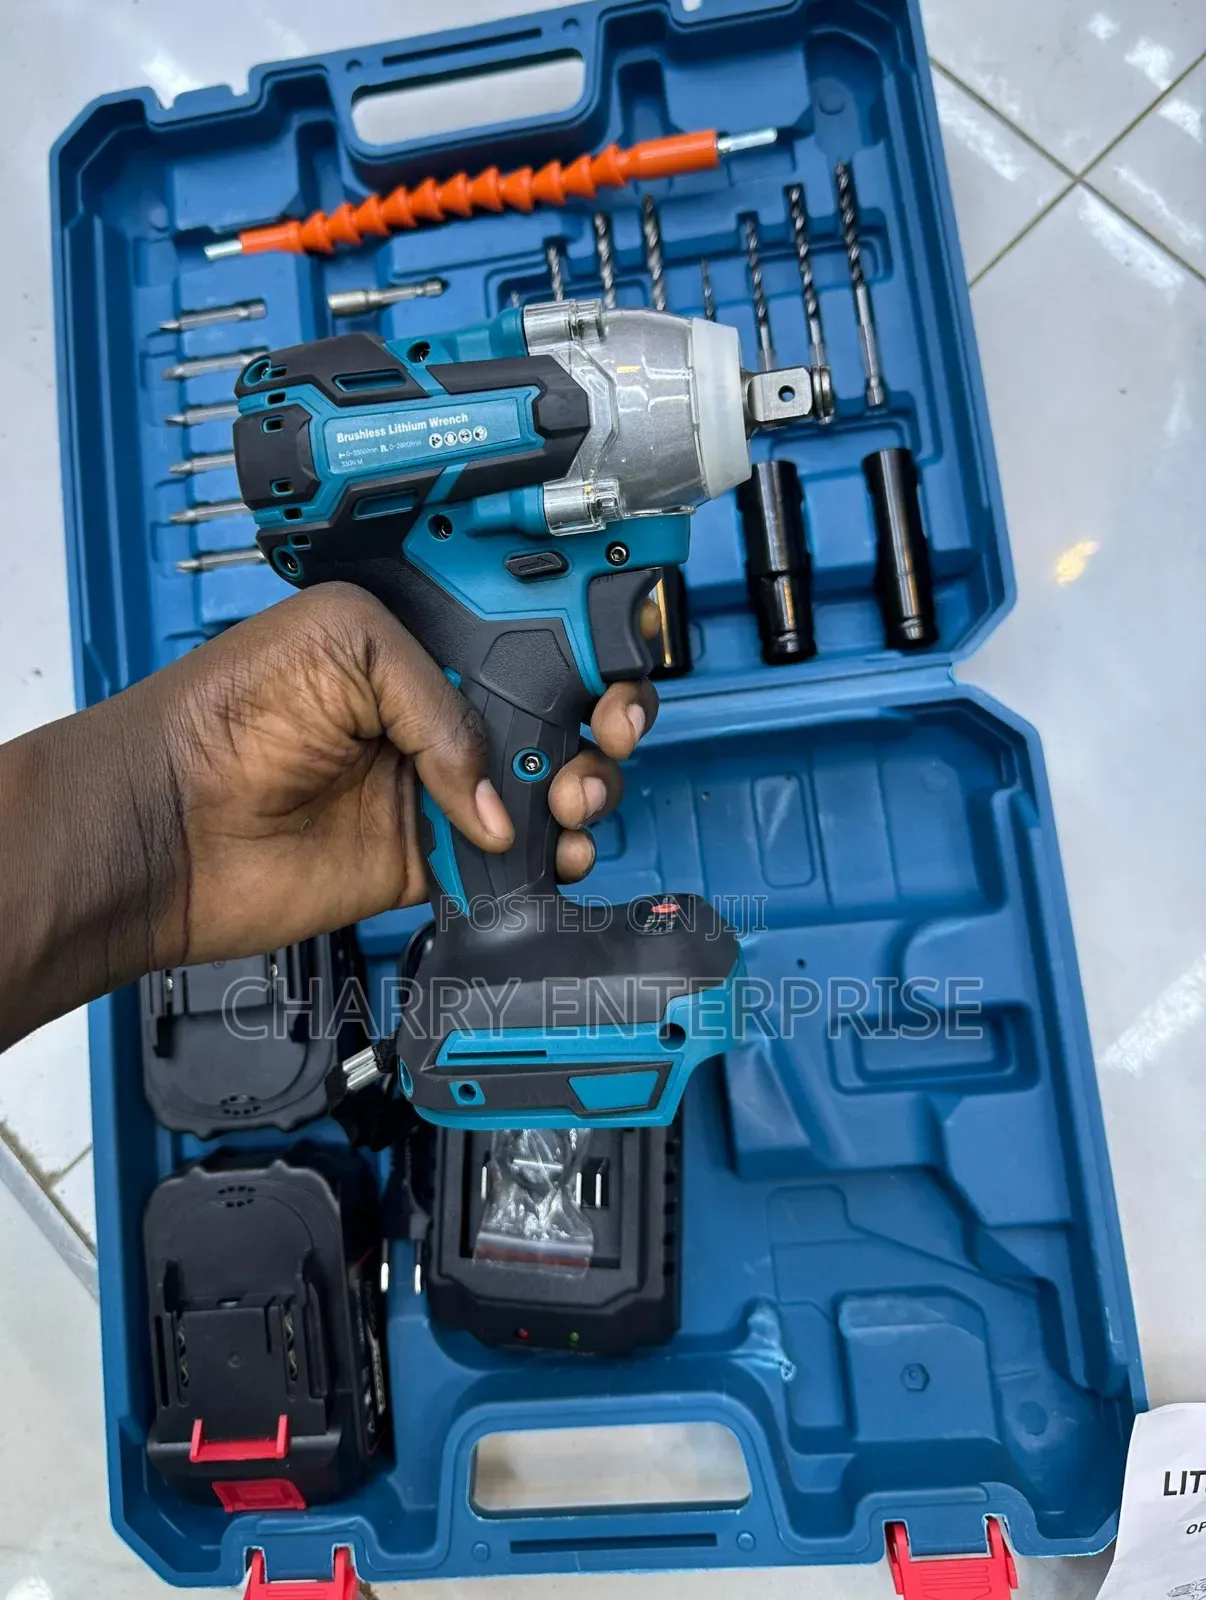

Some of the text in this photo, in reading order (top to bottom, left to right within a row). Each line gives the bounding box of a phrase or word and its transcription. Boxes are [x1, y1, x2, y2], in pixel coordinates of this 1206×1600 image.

[336, 412, 469, 443] Brushless Lithium Wrench
[1163, 1470, 1206, 1496] LIT
